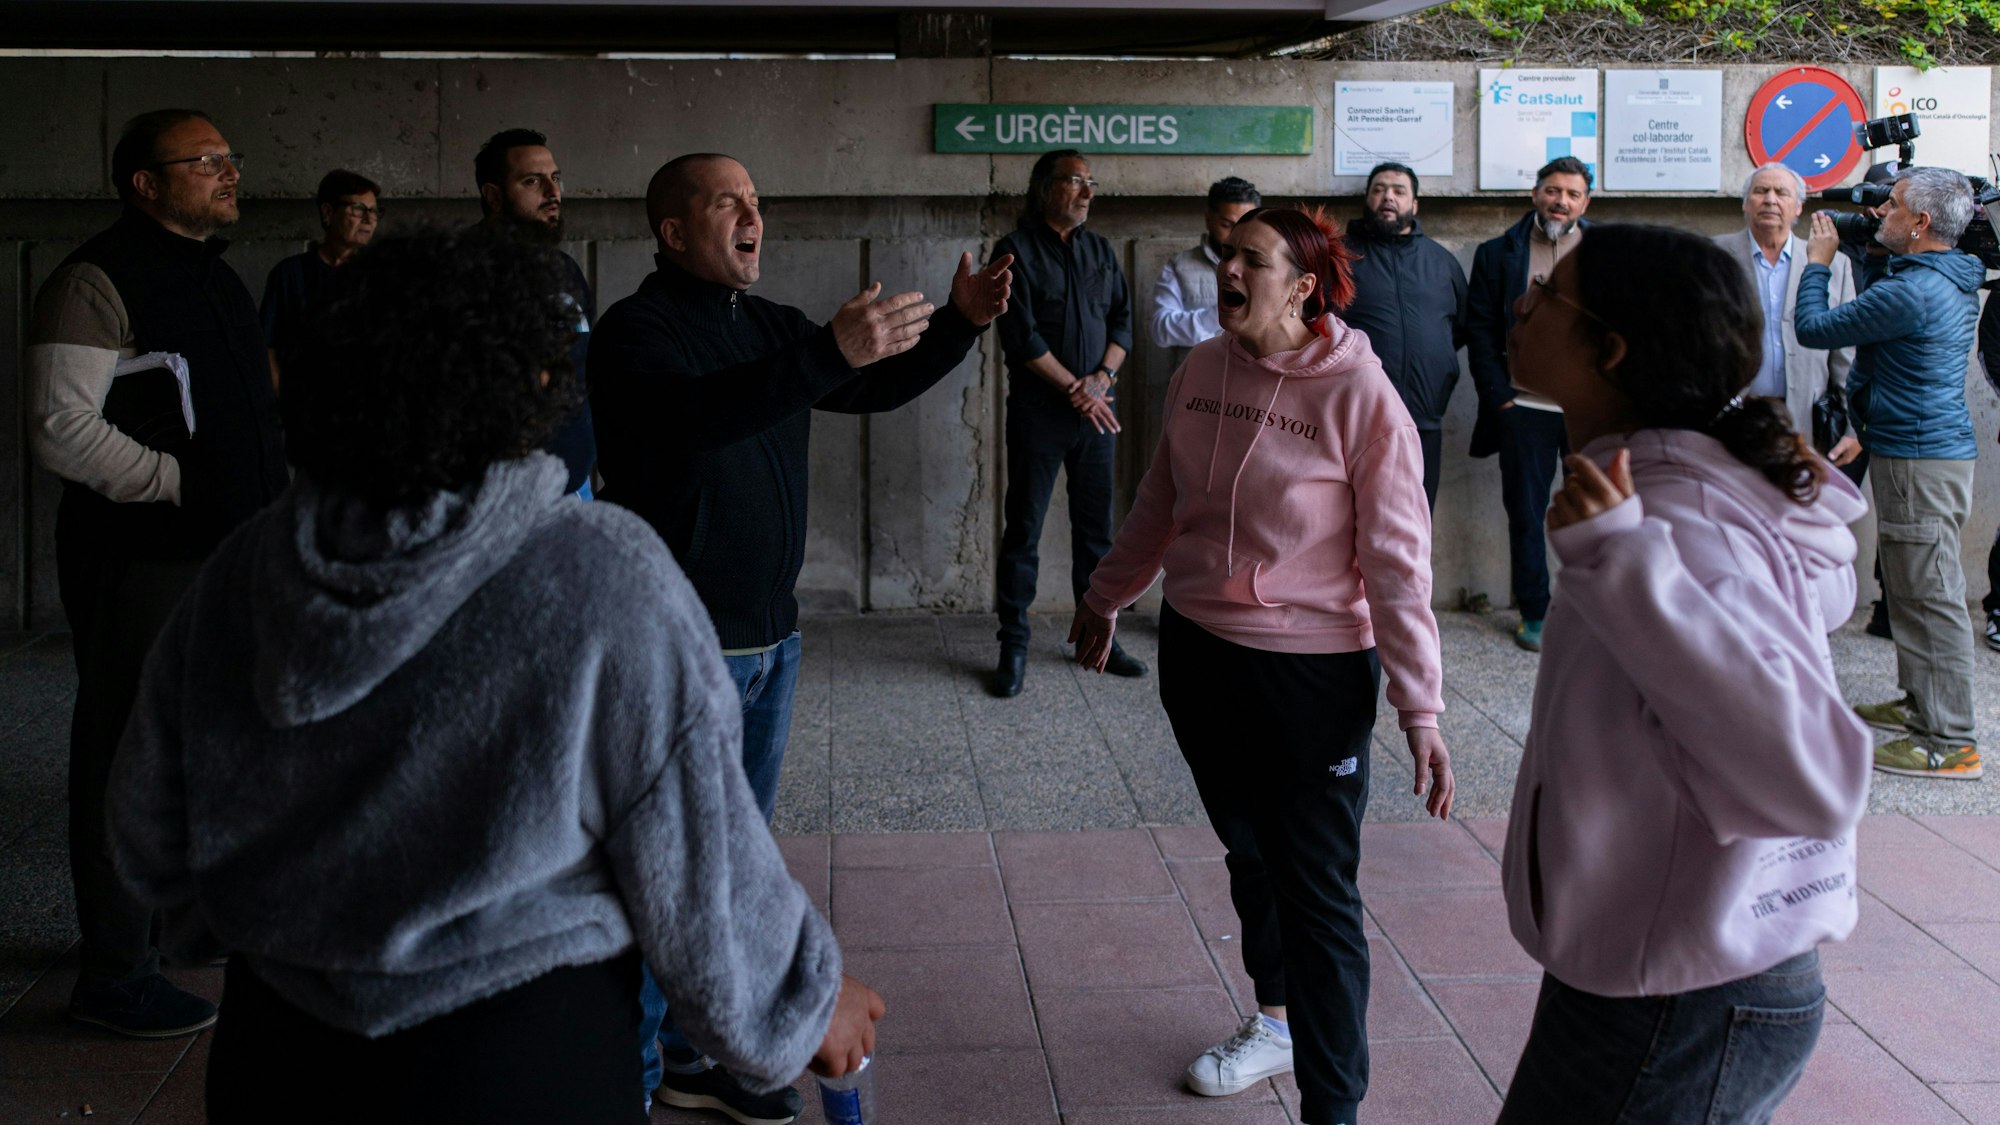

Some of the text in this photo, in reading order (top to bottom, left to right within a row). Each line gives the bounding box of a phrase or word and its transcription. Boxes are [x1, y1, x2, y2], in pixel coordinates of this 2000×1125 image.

[1518, 93, 1583, 105] CatSalut
[1911, 97, 1938, 111] ICO
[1347, 106, 1415, 115] Consorci Sanitari
[995, 106, 1179, 145] URGÈNCIES
[1347, 115, 1360, 123] Alt
[1648, 118, 1680, 131] Centre
[1618, 147, 1646, 155] acreditat
[1648, 148, 1658, 156] per
[1224, 402, 1277, 427] LOVES
[1280, 415, 1319, 441] YOU
[1781, 872, 1847, 908] MIDNIGHT
